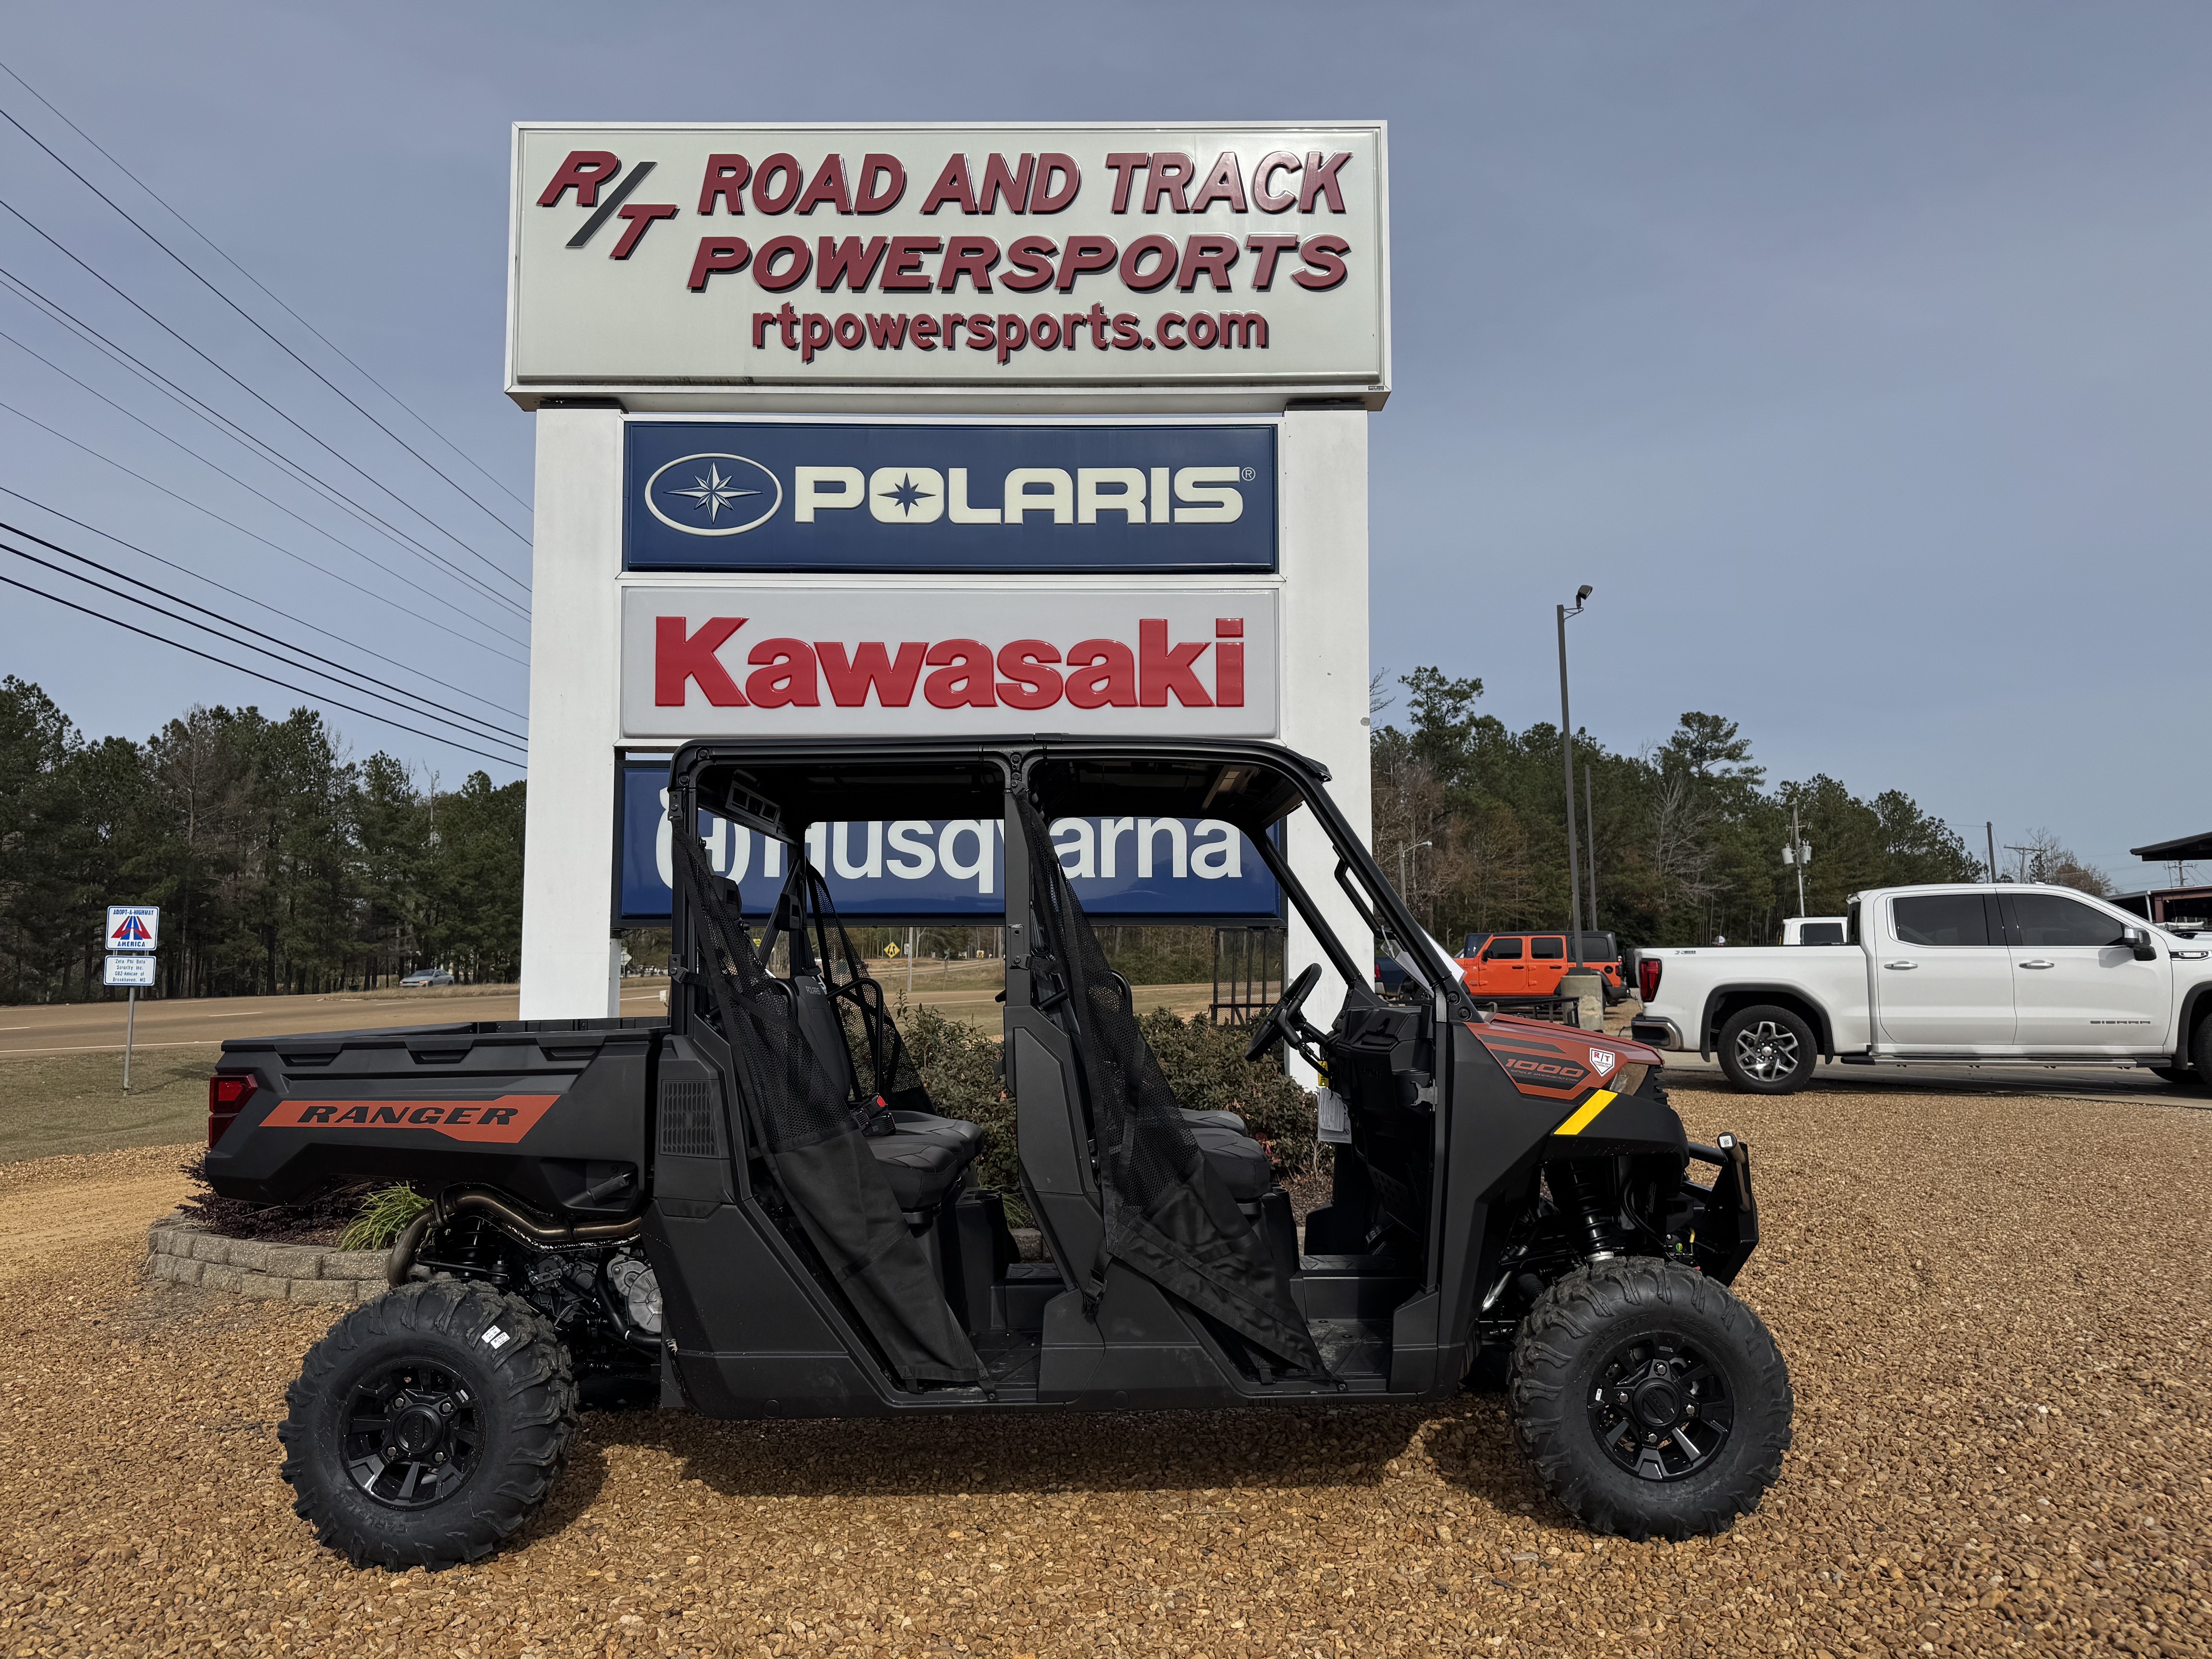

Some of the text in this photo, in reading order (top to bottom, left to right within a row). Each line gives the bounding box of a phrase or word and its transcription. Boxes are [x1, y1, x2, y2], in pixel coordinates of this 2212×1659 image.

[697, 151, 1352, 215] ROAD AND TRACK
[687, 234, 1351, 293] POWERSPORTS
[752, 300, 1269, 365] rtpowersports.com
[654, 616, 1245, 710] Kawasaki
[764, 817, 1242, 893] Husqarna
[1505, 1058, 1584, 1078] 1000
[1594, 1052, 1610, 1062] R/T
[297, 1105, 519, 1125] RANGER
